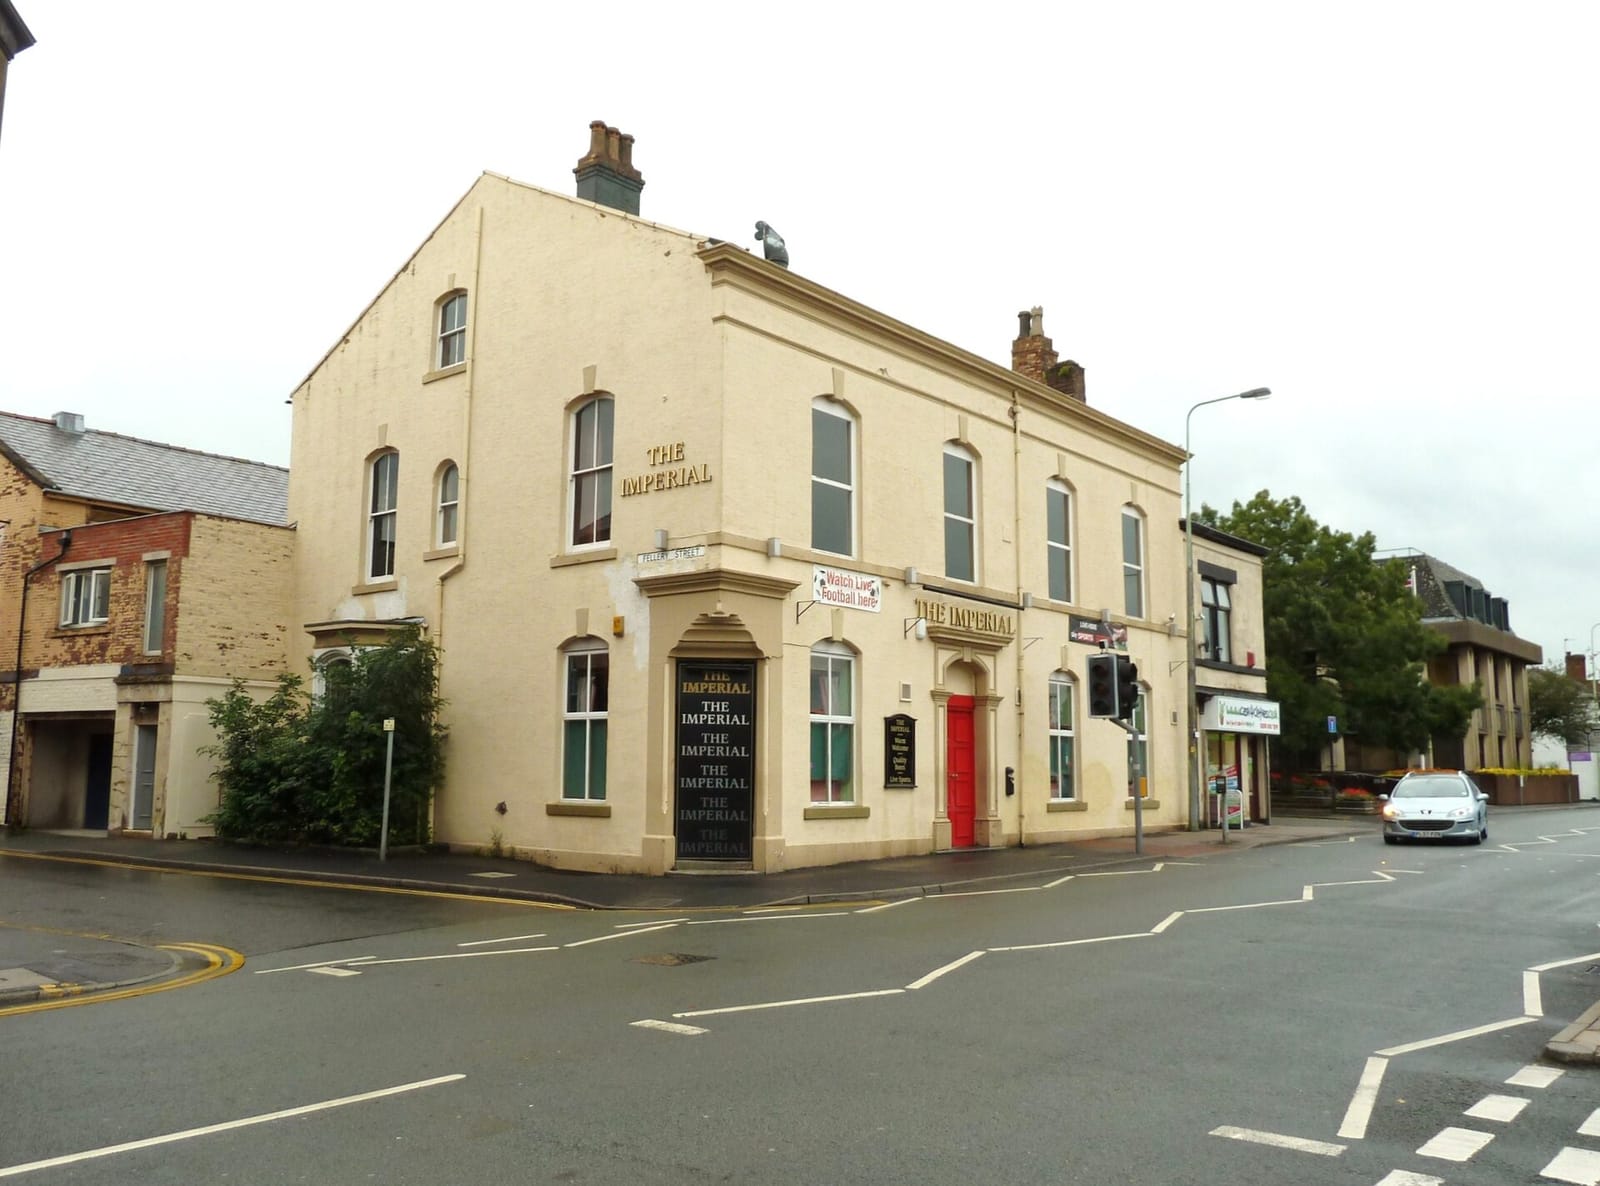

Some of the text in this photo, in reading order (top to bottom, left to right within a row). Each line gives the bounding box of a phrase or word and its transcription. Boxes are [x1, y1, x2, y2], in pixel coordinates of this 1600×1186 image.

[646, 442, 685, 466] THE
[620, 464, 713, 498] IMPERIAL
[674, 547, 700, 558] STREET
[826, 570, 873, 591] Watch Live
[822, 586, 876, 608] Football here
[914, 598, 1016, 634] THE IMPERIAL
[682, 682, 751, 694] IMPERIAL
[701, 701, 730, 712] THE
[682, 713, 750, 725] IMPERIAL
[701, 733, 729, 744] THE
[681, 745, 750, 757] IMPERIAL
[700, 765, 729, 776] THE
[680, 777, 749, 789] IMPERIAL
[700, 797, 729, 808] THE
[680, 809, 748, 821] IMPERIAL
